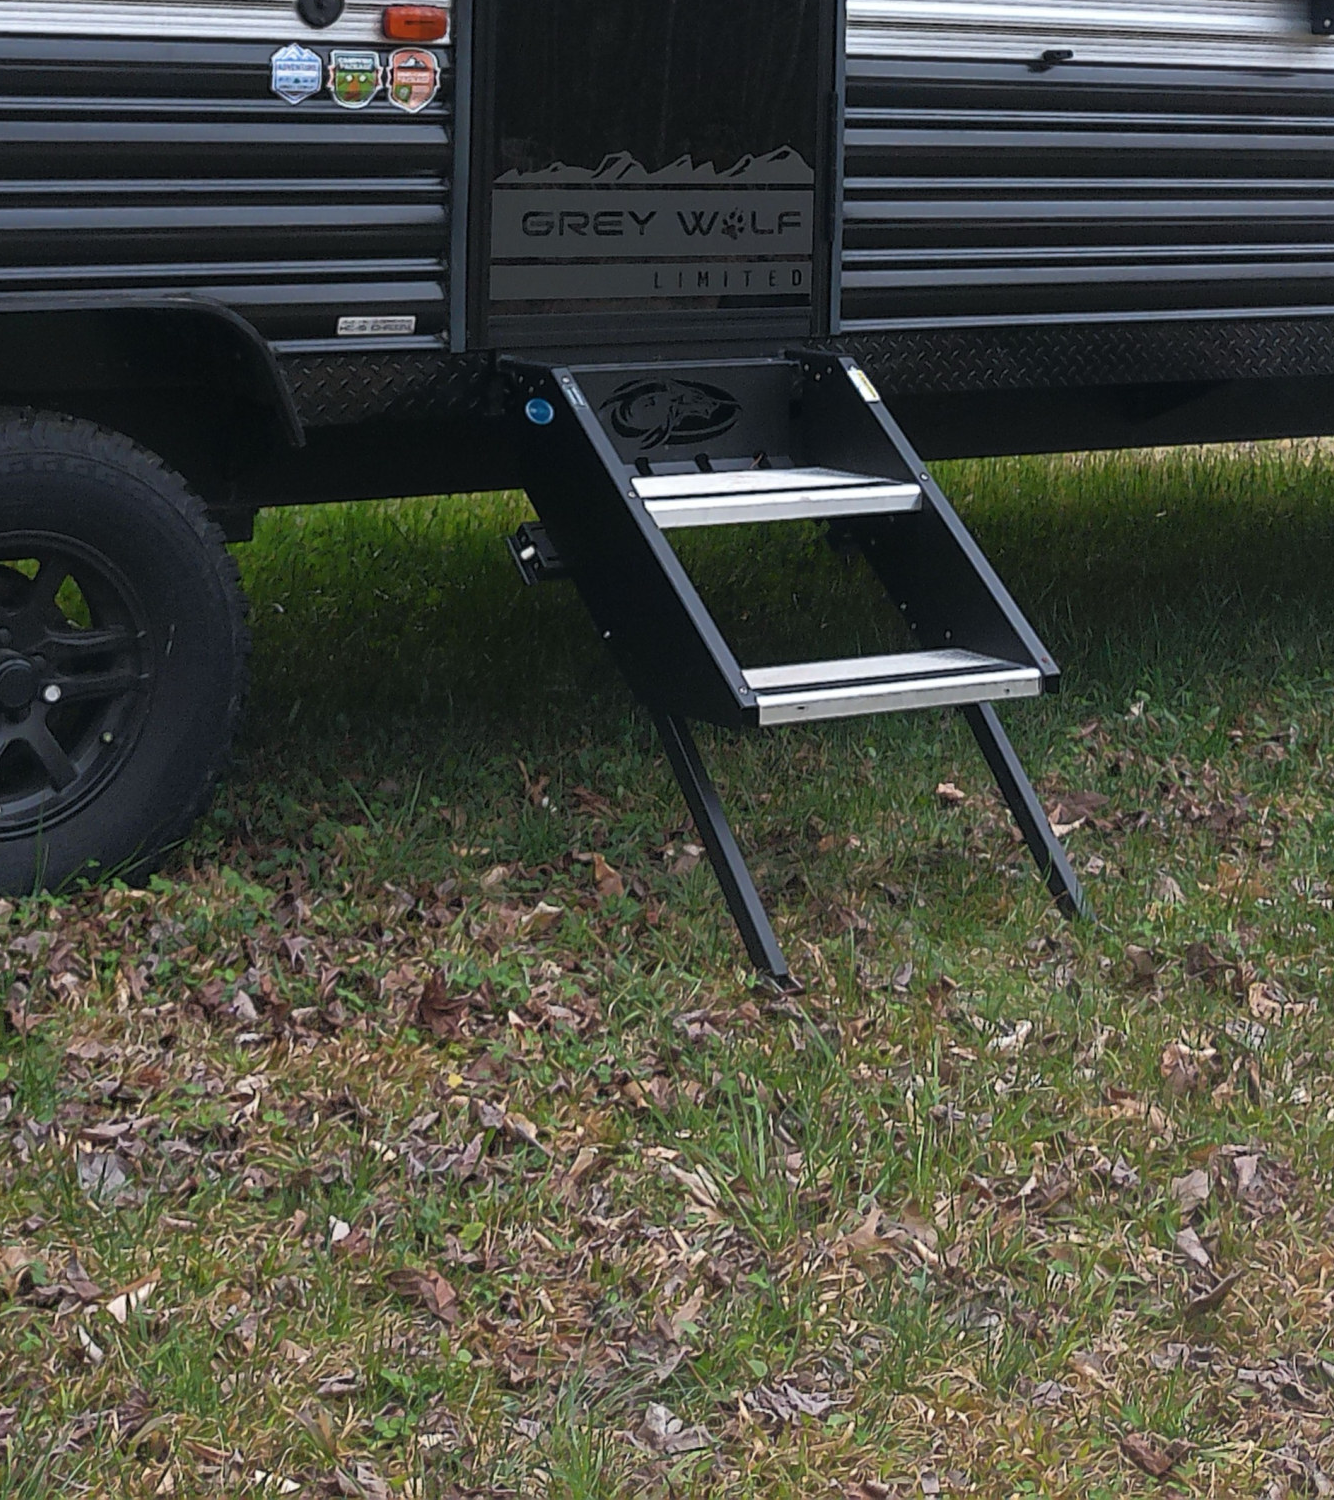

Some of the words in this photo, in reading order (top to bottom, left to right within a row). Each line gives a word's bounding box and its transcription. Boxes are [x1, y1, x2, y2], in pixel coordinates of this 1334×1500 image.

[522, 210, 657, 237] GREY
[676, 208, 802, 240] WLF
[653, 268, 803, 289] LIMITED
